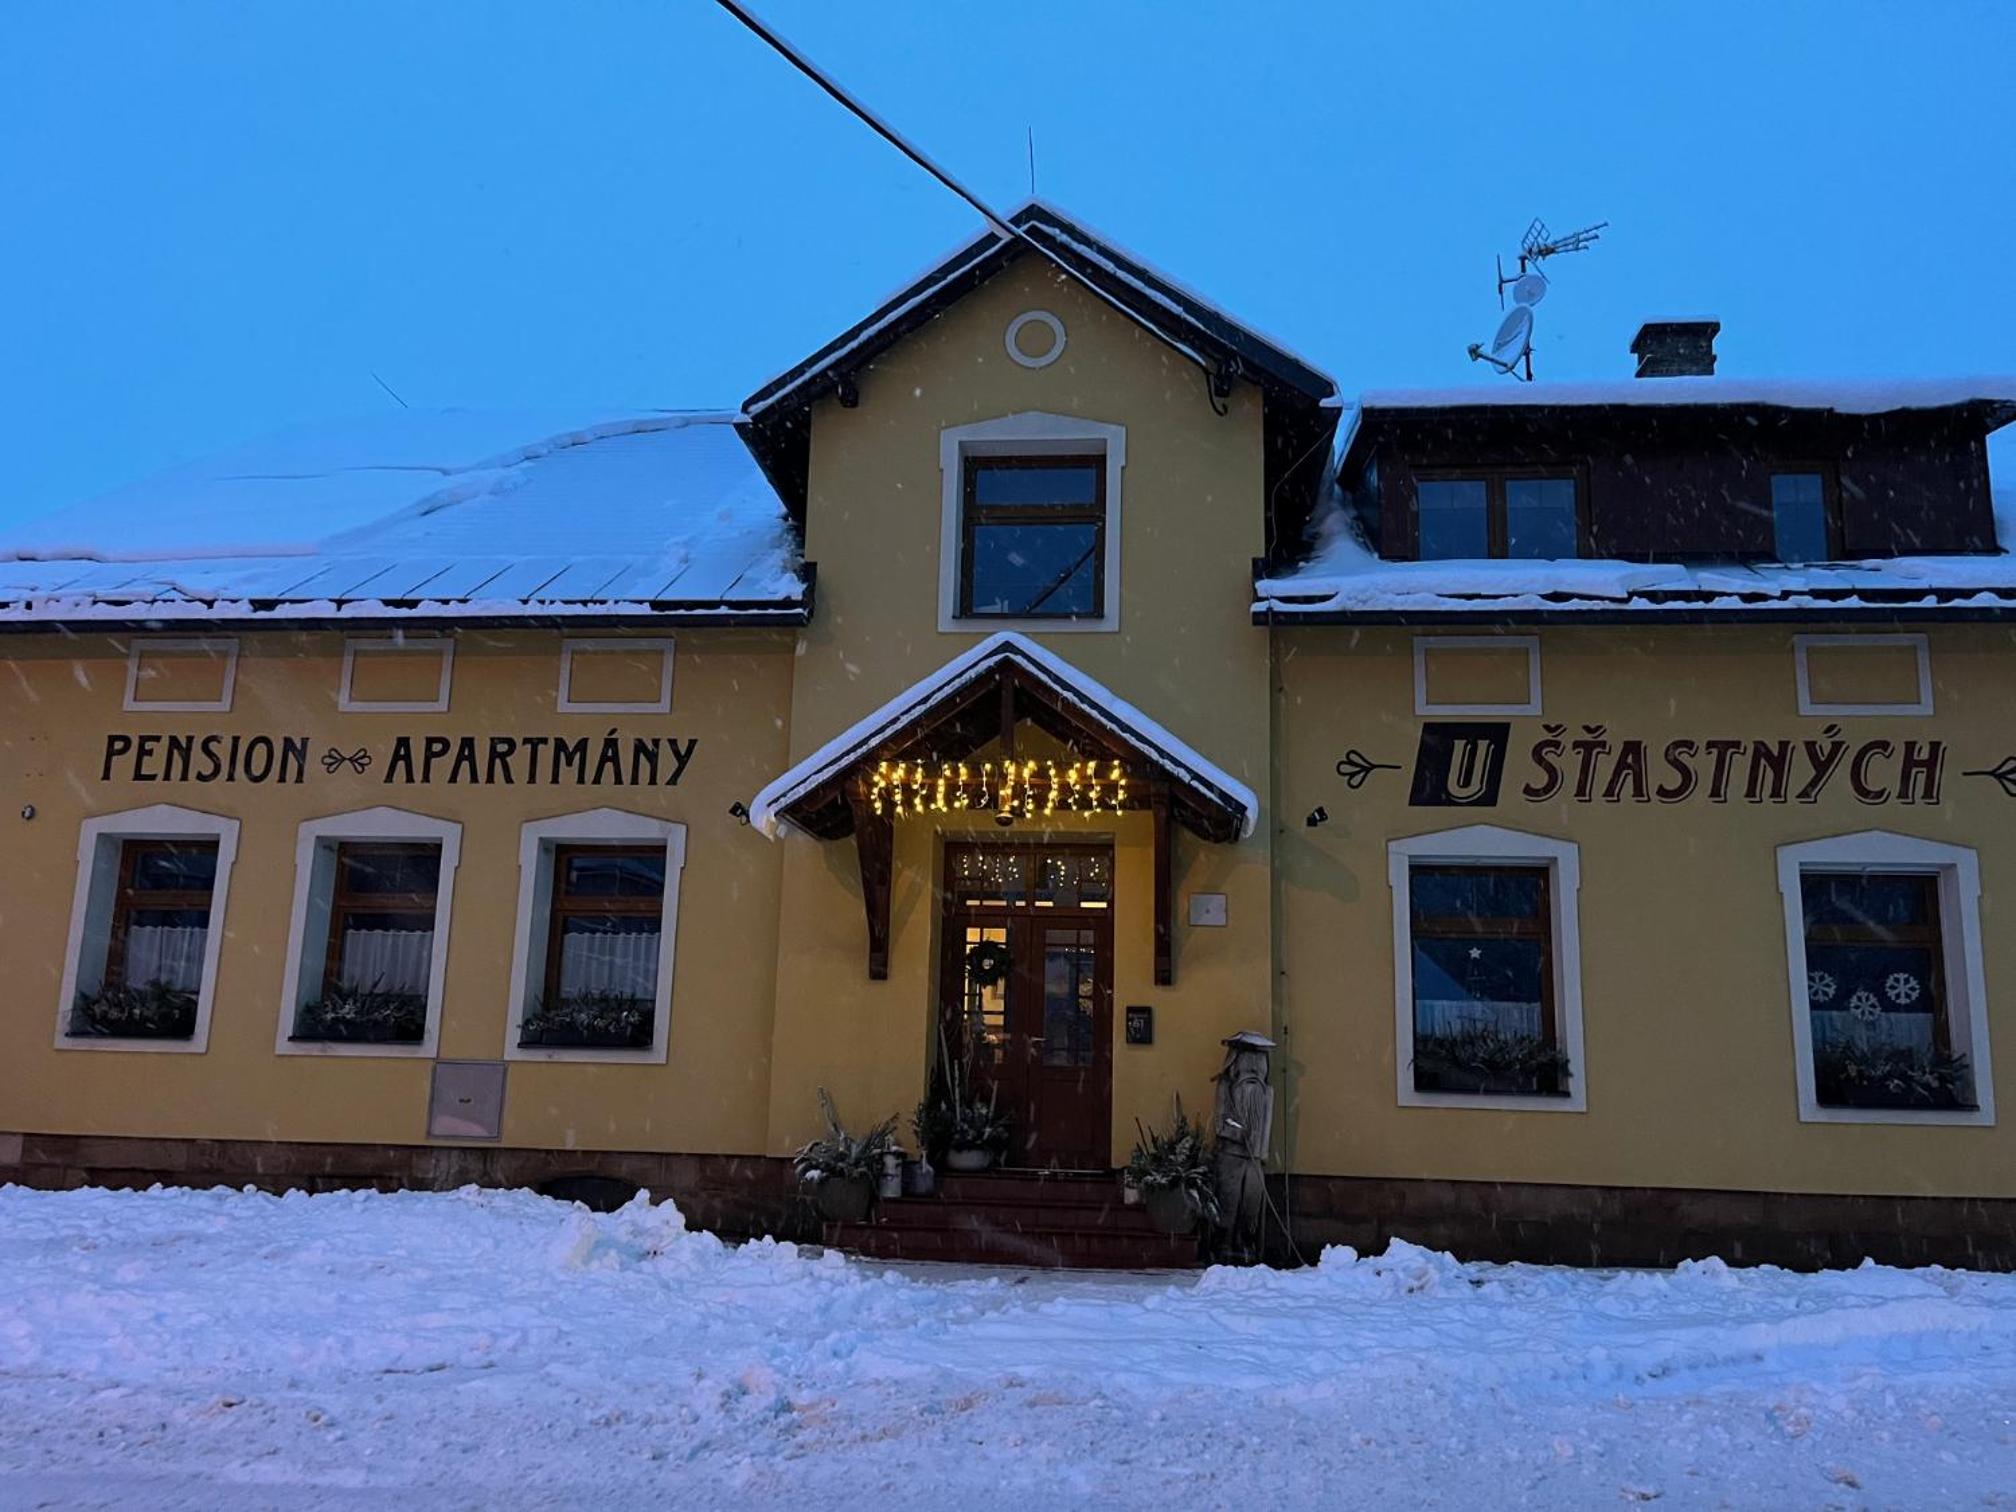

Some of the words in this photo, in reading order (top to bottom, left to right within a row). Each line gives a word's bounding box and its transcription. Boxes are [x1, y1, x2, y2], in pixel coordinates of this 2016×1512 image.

[100, 733, 309, 783] PENSION
[384, 728, 698, 786] APARTMÁNY
[1446, 738, 1494, 801] U
[1522, 723, 1947, 804] ŠŤASTNÝCH
